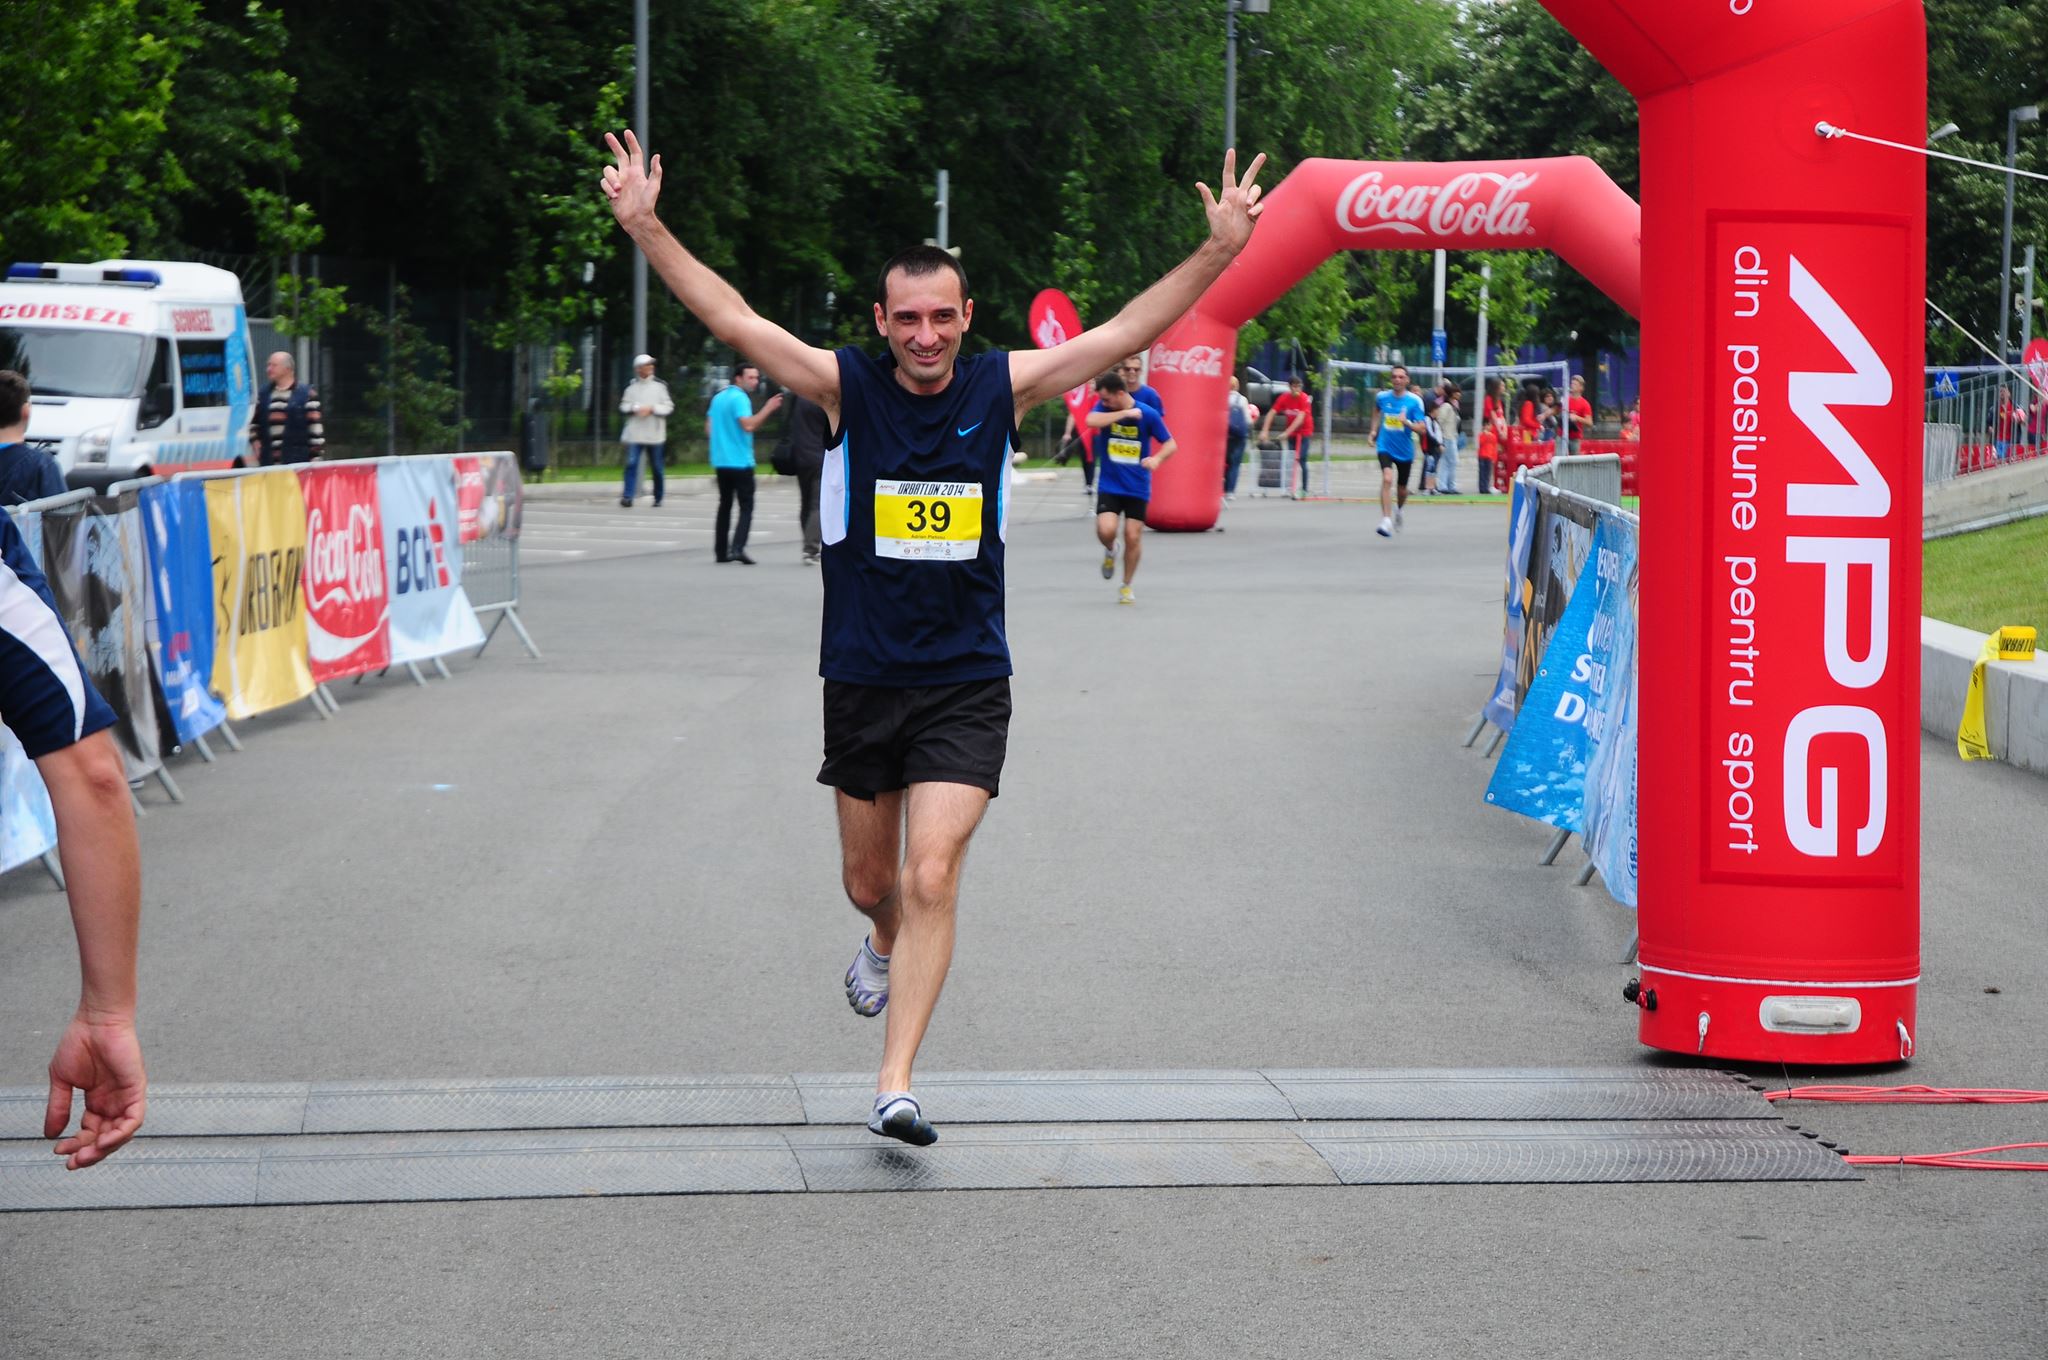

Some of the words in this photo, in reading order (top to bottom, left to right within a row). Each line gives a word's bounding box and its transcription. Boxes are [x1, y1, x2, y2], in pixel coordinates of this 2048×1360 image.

[1335, 171, 1538, 235] Coca-Cola
[1734, 245, 1769, 318] din
[1151, 342, 1224, 376] Coca-Cola
[1727, 344, 1767, 531] pasiune
[897, 482, 941, 496] URBATLON
[941, 484, 965, 496] 2014
[906, 500, 951, 533] 39
[1783, 253, 1893, 856] MPG
[1724, 555, 1761, 706] pentru
[1722, 731, 1760, 855] sport
